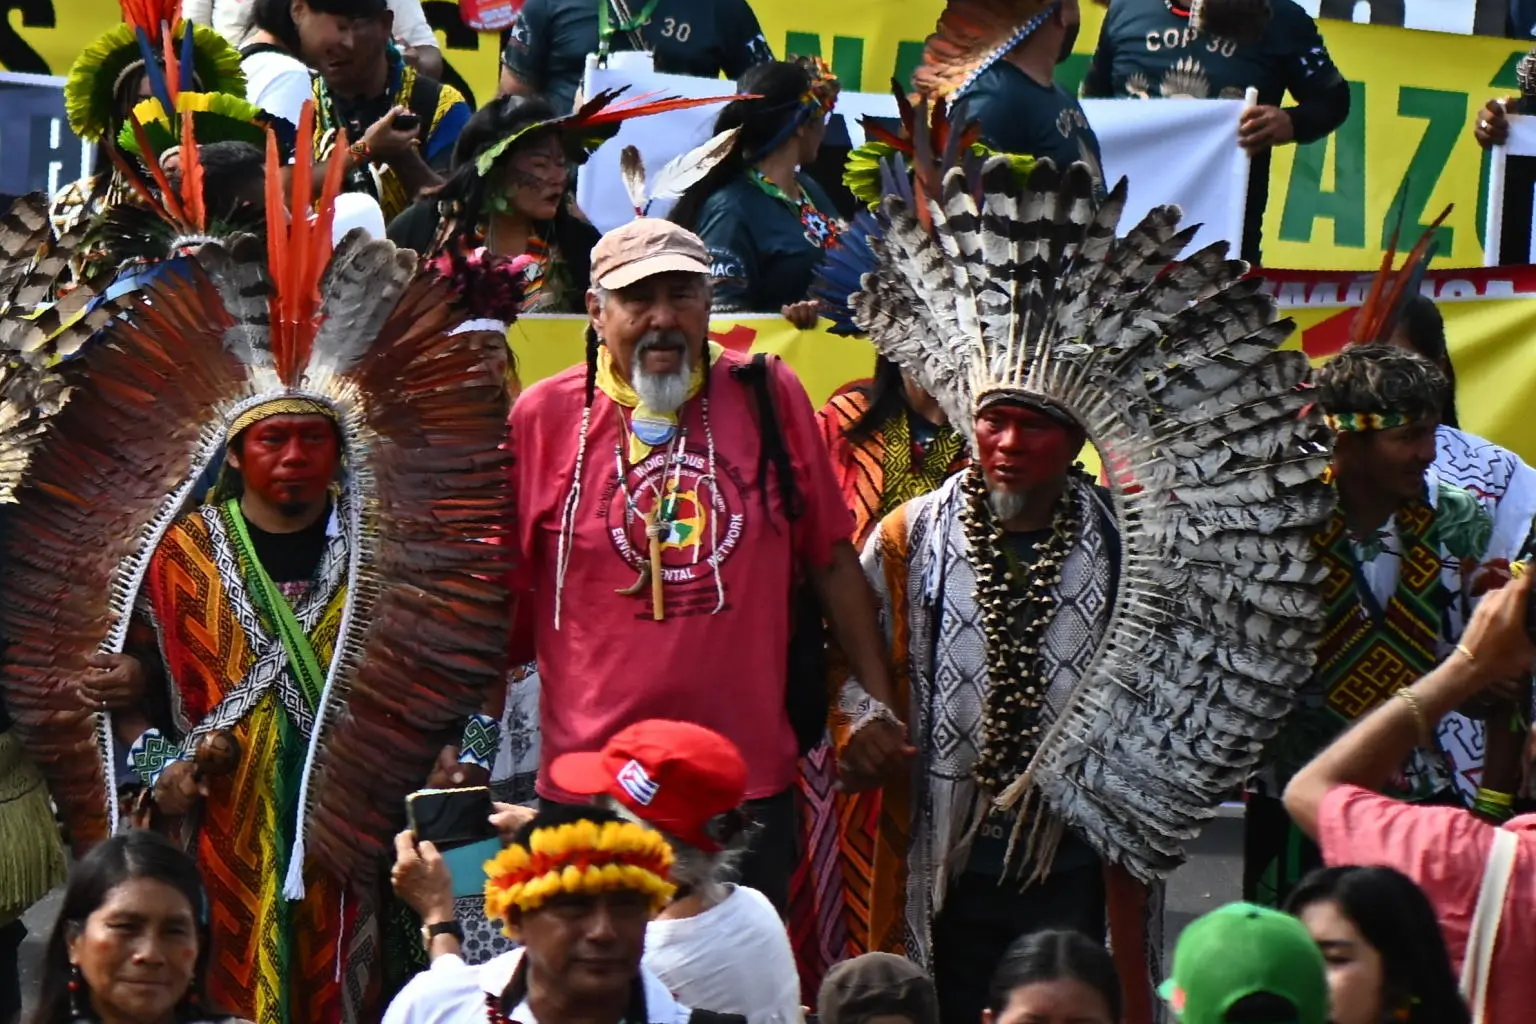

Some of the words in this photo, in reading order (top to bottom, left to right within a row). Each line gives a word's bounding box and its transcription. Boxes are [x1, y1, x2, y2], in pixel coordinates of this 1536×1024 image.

[660, 17, 691, 42] 30
[1146, 28, 1197, 52] COP
[1206, 37, 1237, 58] 30
[633, 452, 706, 479] INDIGOUS
[707, 513, 744, 568] NETWORK
